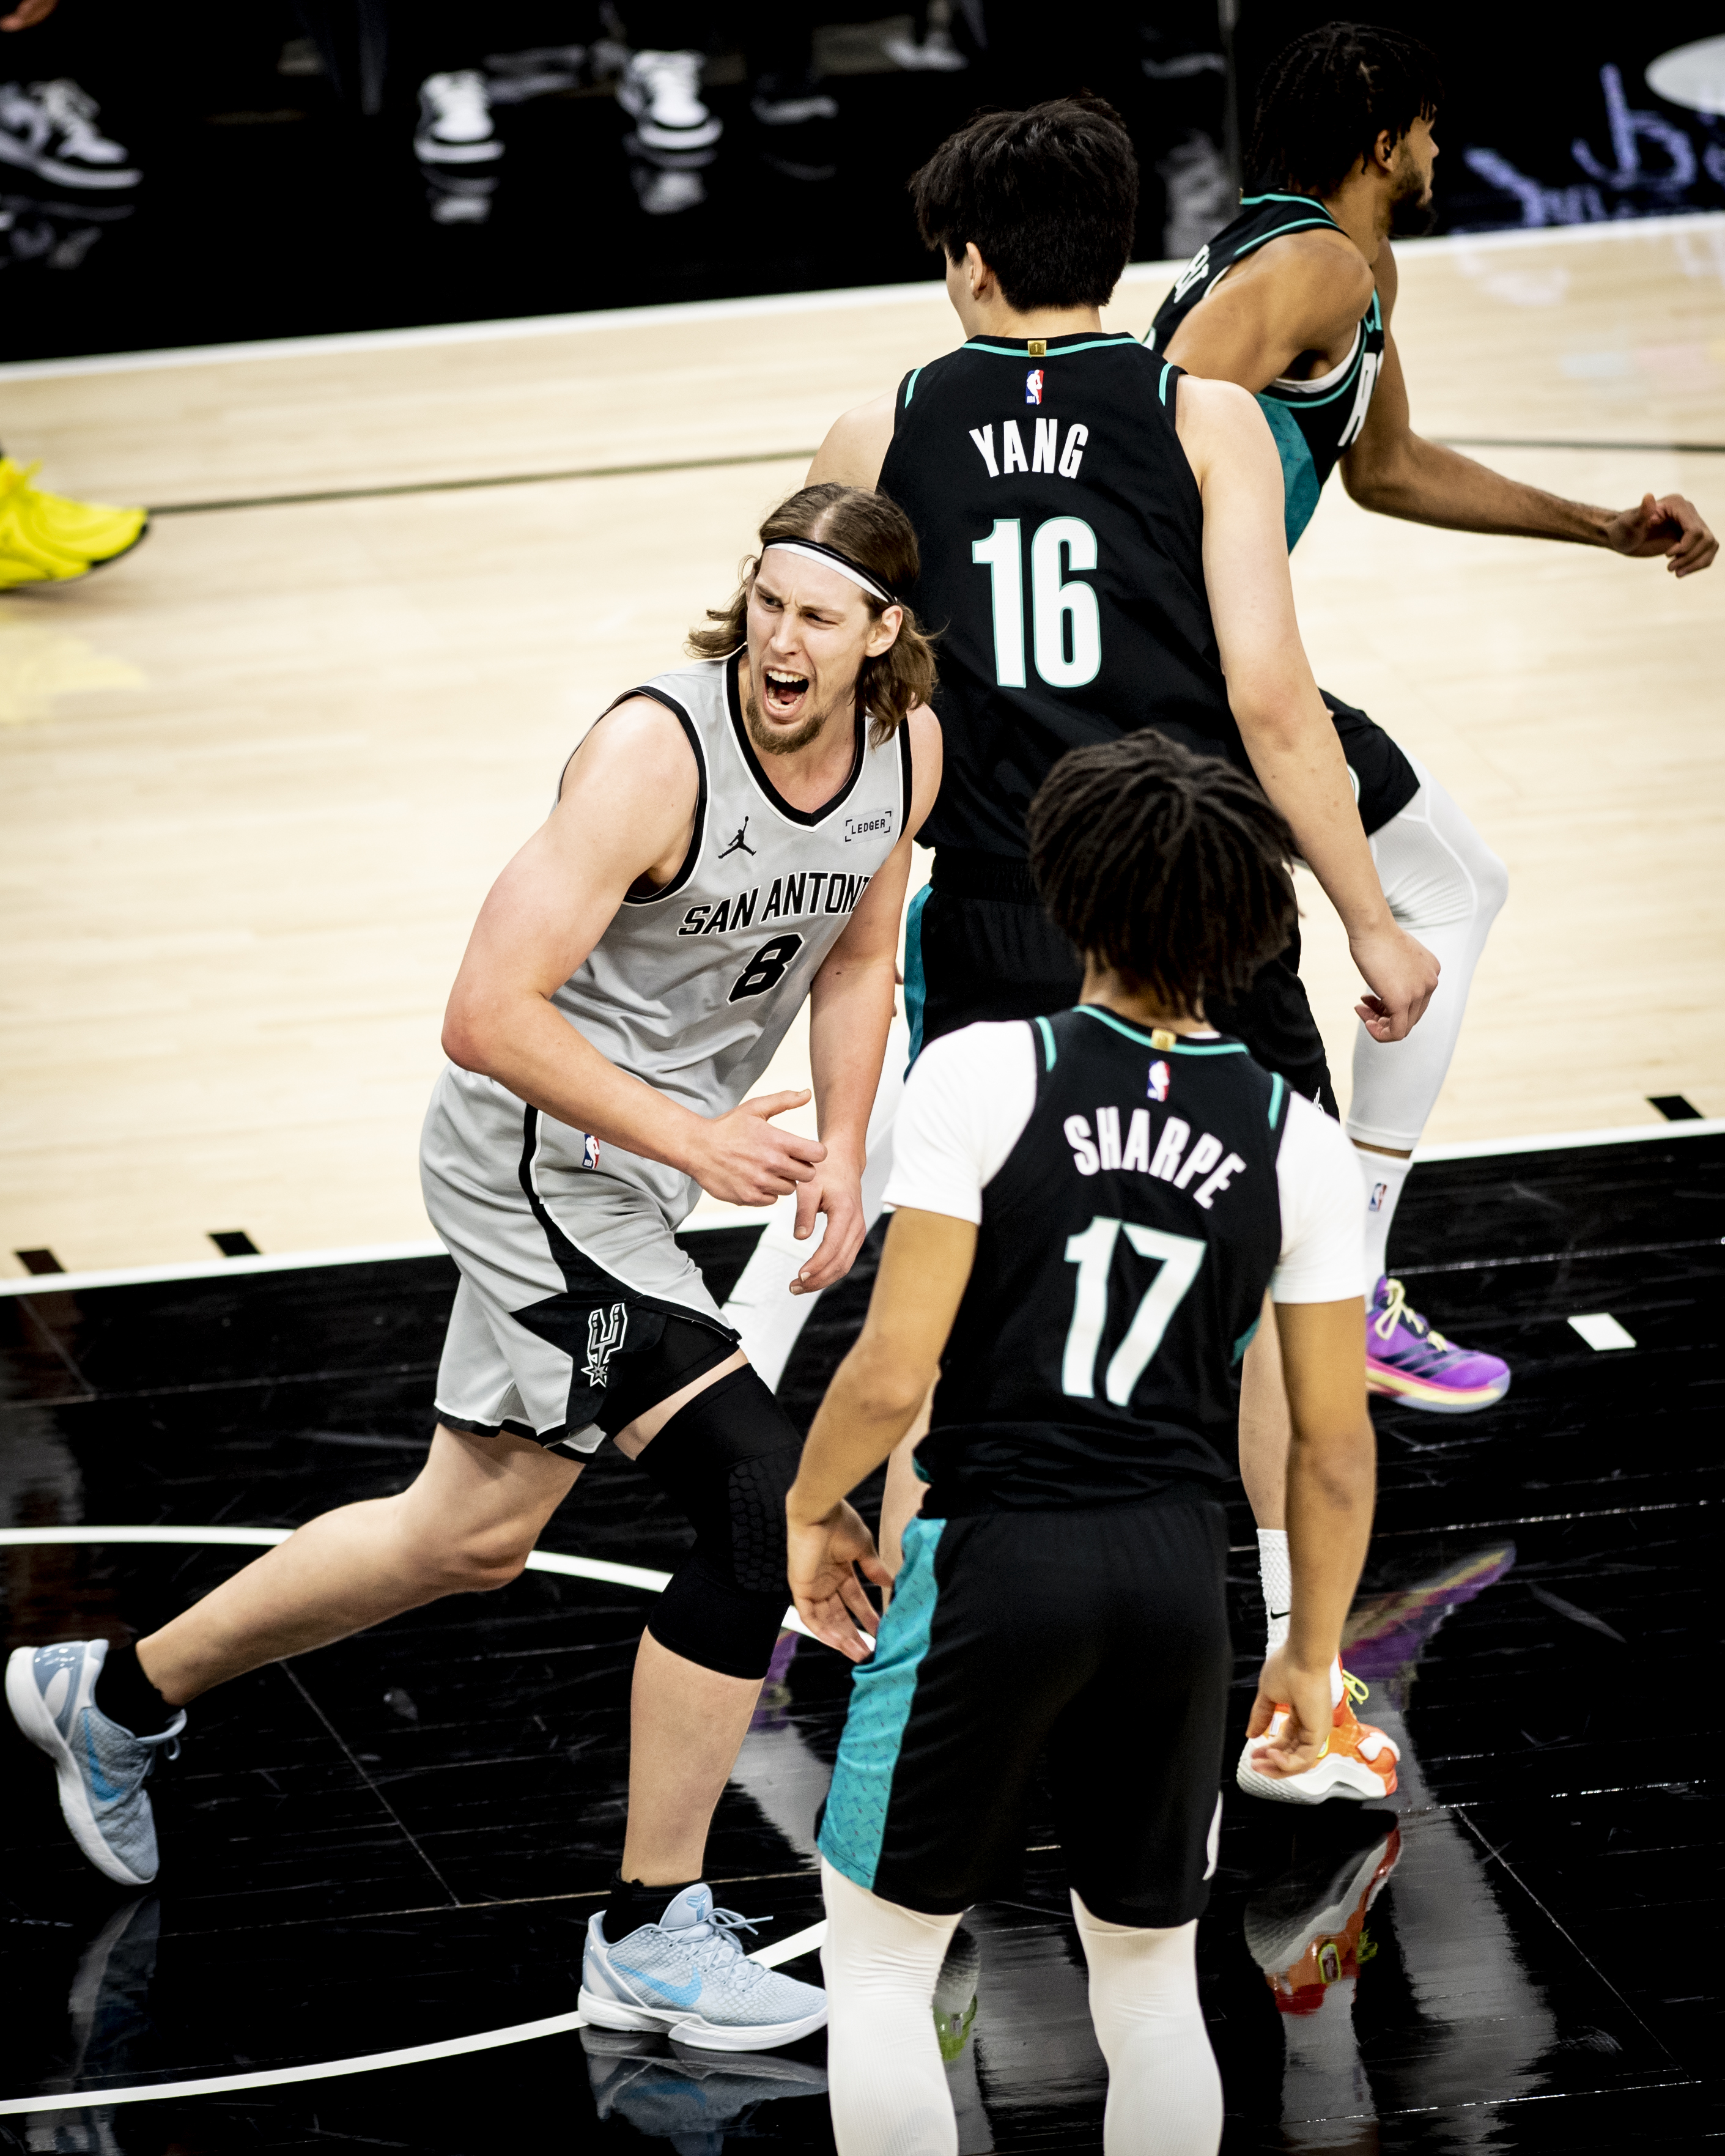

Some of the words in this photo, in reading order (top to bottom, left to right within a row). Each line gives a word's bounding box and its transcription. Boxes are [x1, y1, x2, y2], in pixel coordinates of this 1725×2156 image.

[969, 418, 1089, 479] YANG
[972, 516, 1102, 689] 16
[851, 818, 885, 835] LEDGER
[677, 885, 761, 937] SAN
[758, 870, 873, 925] ANTONI
[726, 932, 805, 1005] 8
[1063, 1106, 1247, 1210] SHARPE
[1062, 1216, 1208, 1407] 17
